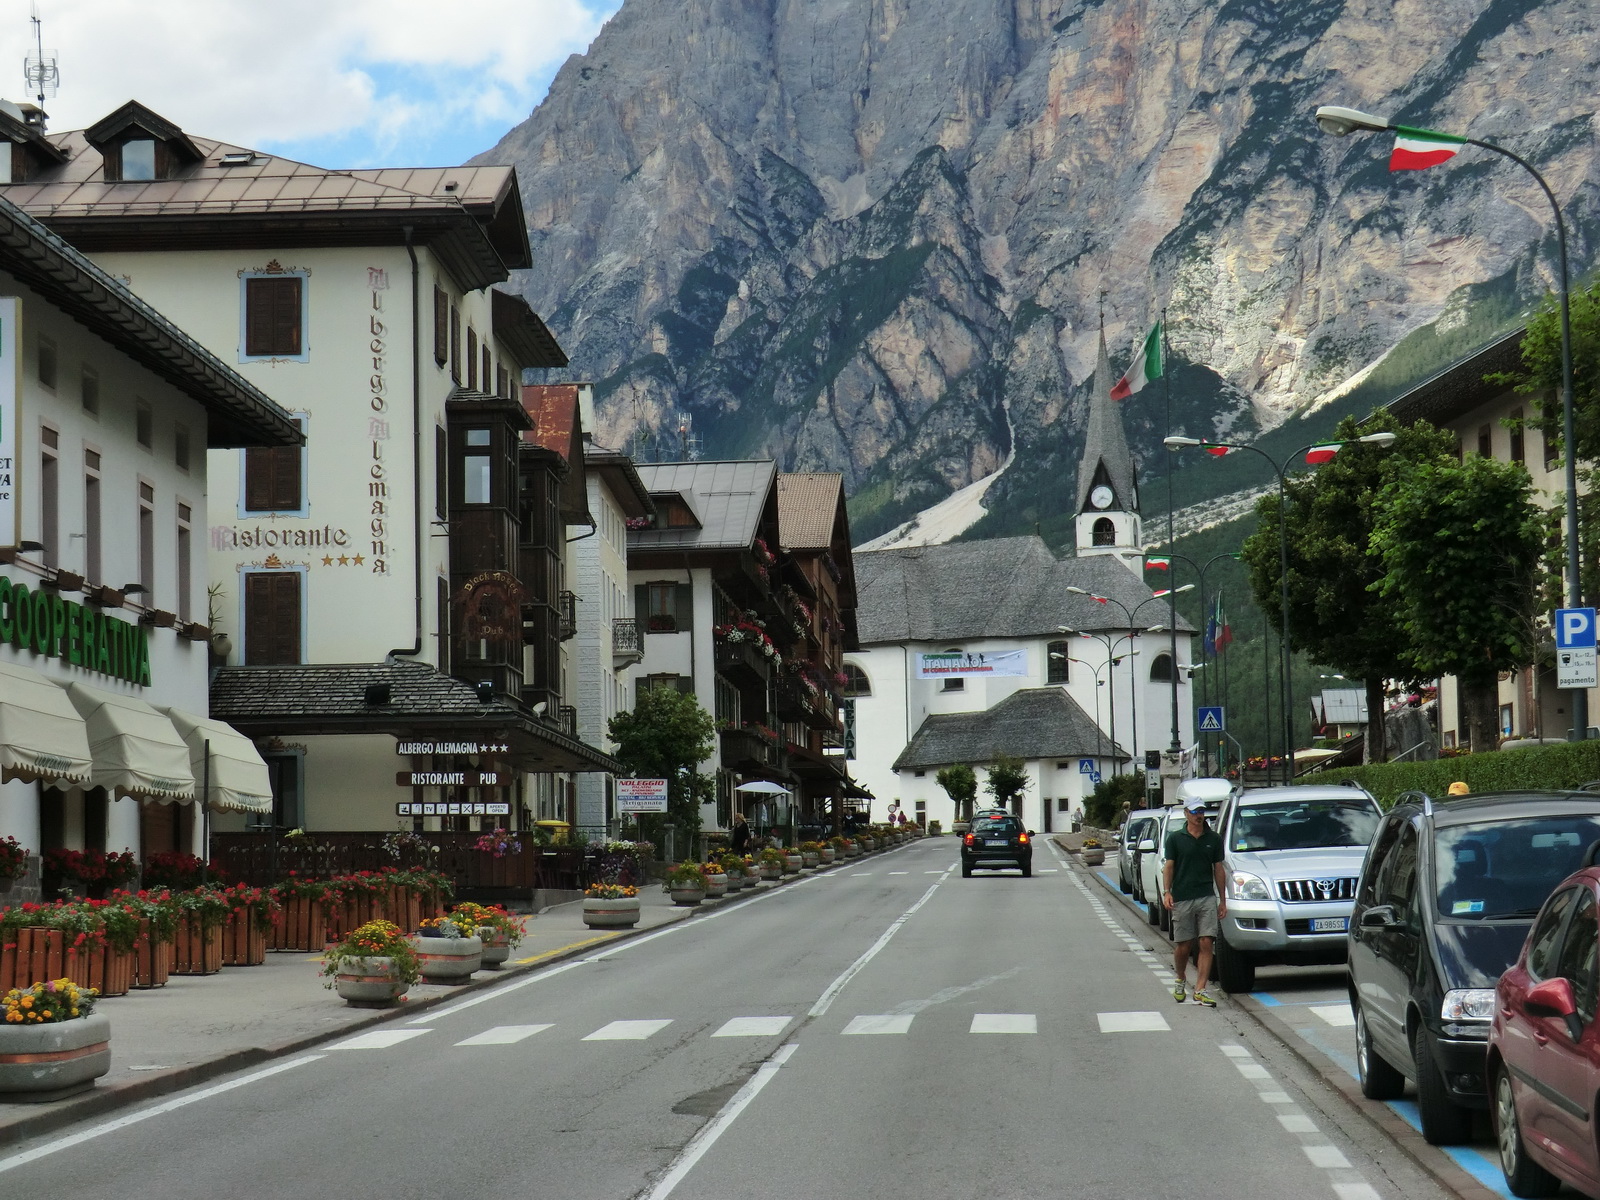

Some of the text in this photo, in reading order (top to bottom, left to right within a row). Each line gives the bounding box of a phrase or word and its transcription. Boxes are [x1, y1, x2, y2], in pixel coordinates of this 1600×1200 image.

[367, 266, 391, 575] Albergo Alemagna
[210, 525, 350, 551] Ristorante
[0, 575, 152, 687] COOPERATIVA
[1563, 612, 1588, 645] P
[1560, 677, 1595, 686] pagamento
[845, 699, 855, 760] NEVADA
[399, 743, 478, 754] ALBERGO ALEMAGNA
[412, 773, 497, 784] RISTORANTE PUB
